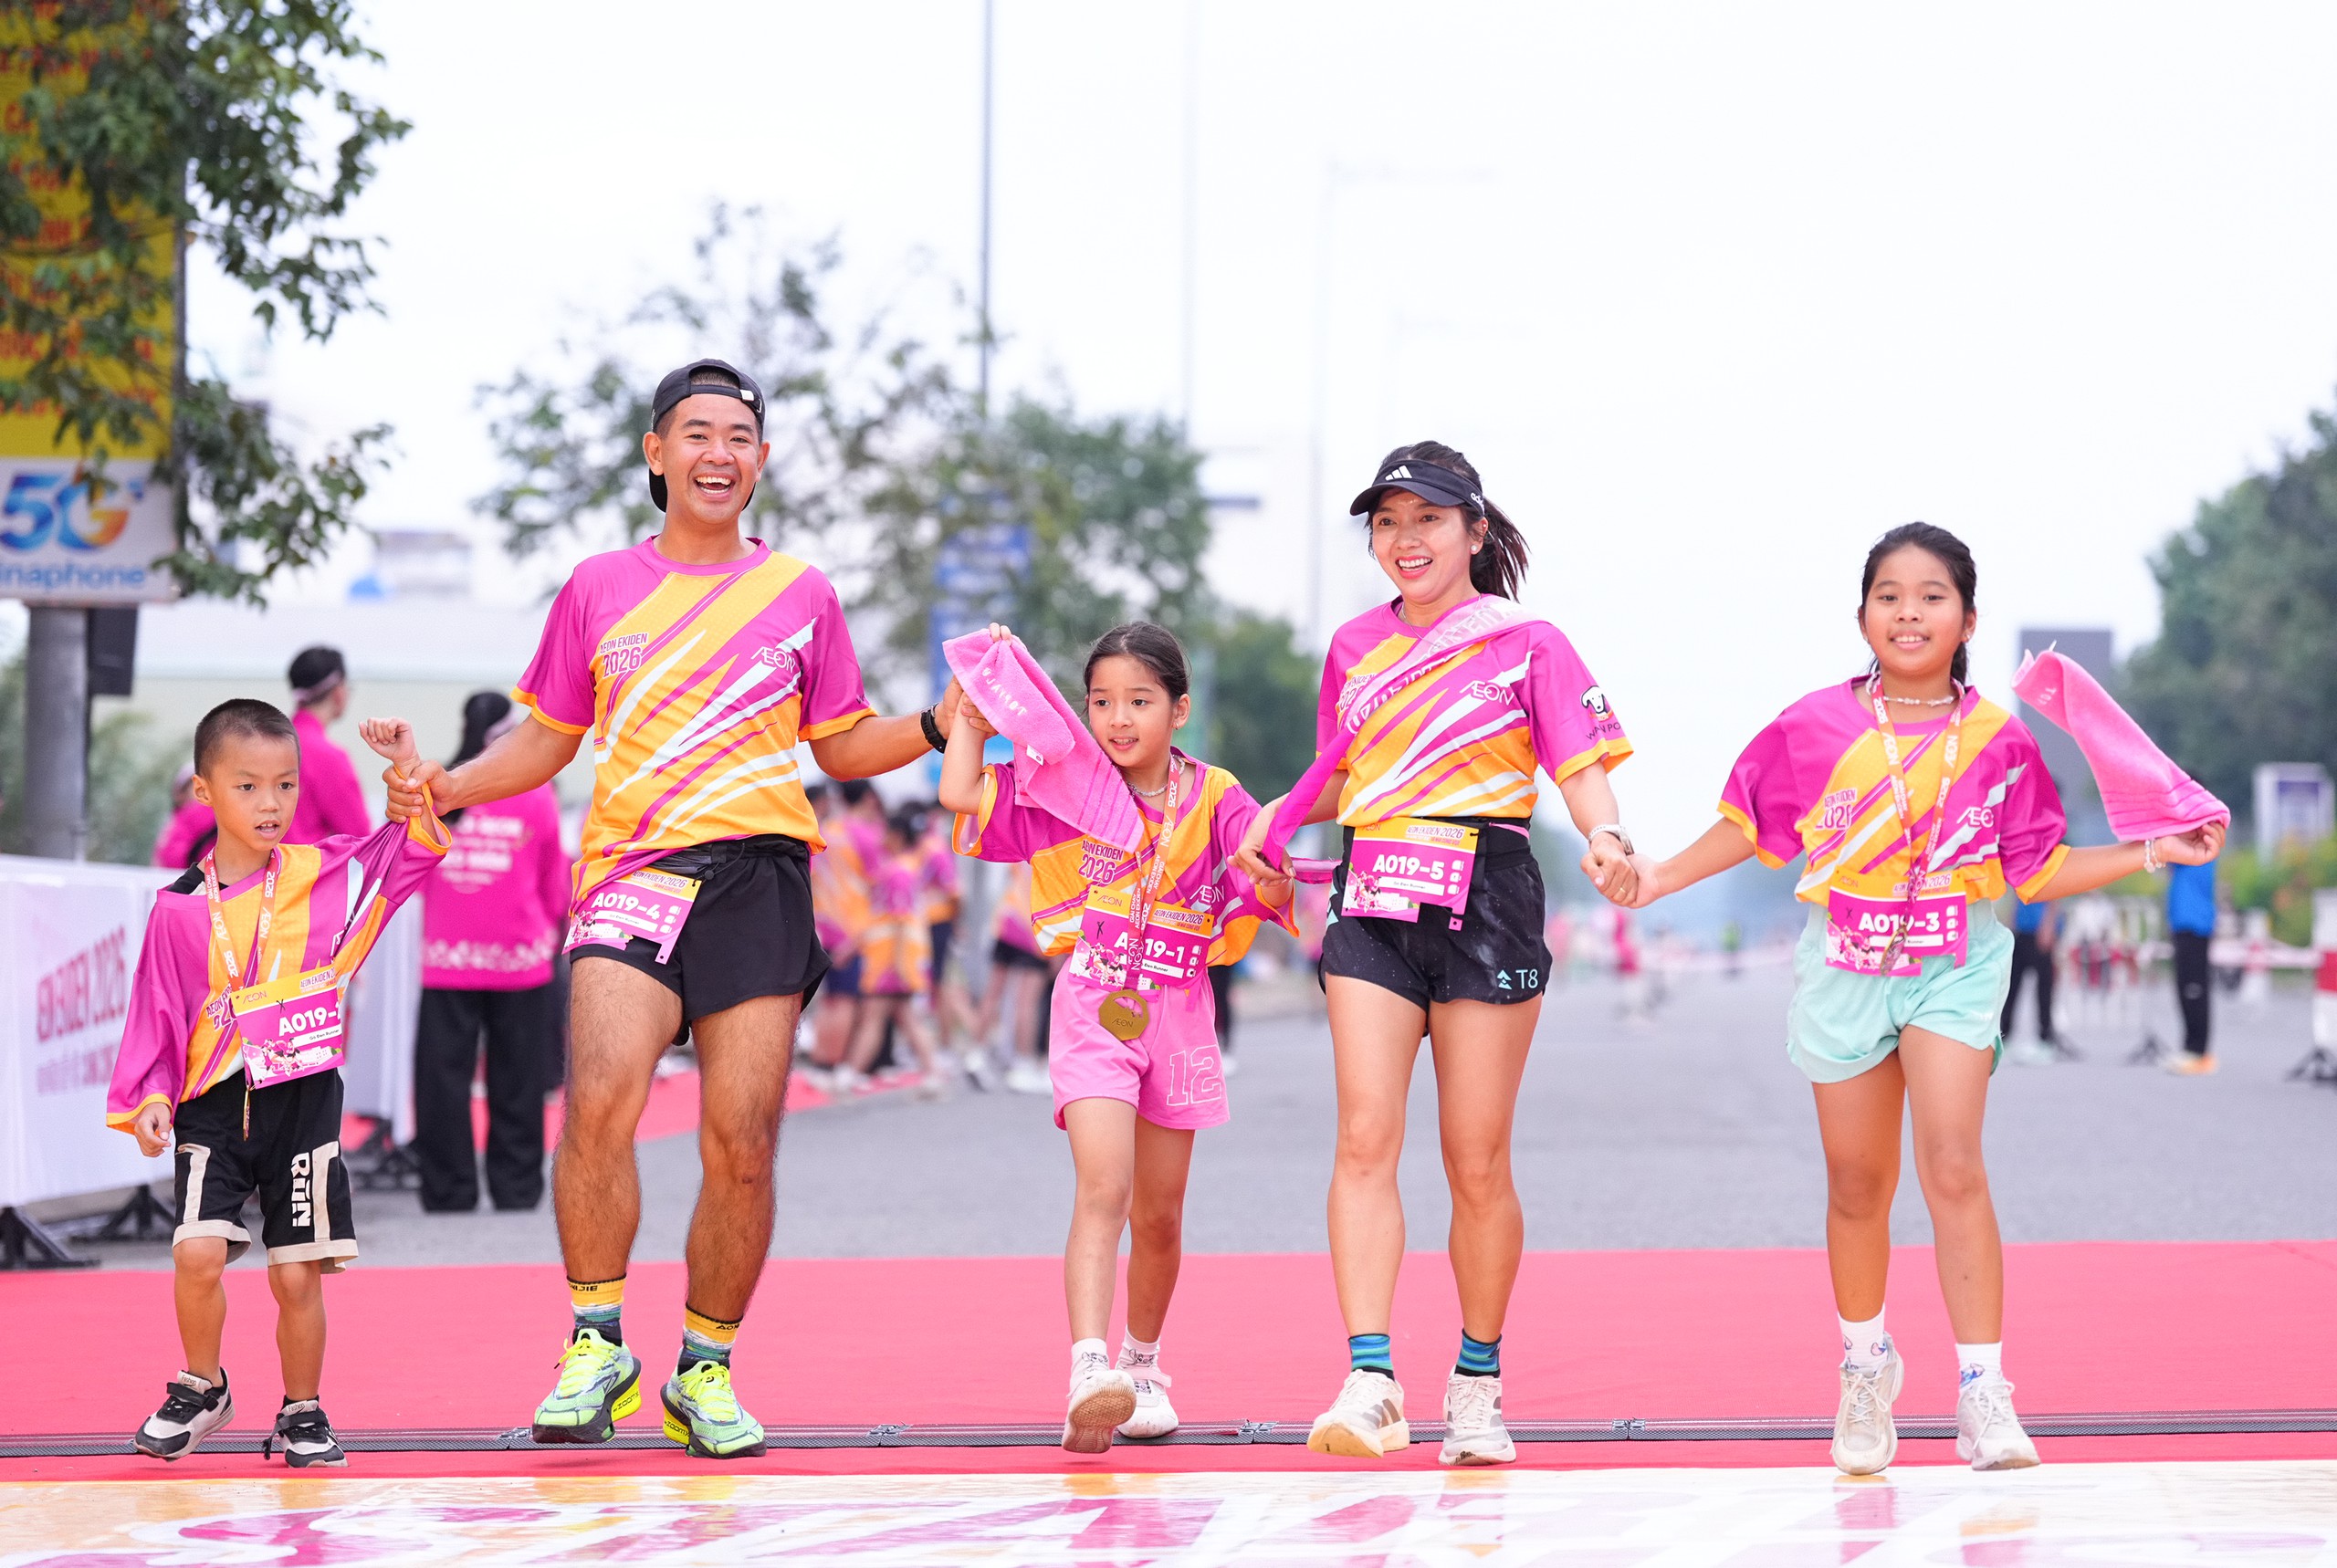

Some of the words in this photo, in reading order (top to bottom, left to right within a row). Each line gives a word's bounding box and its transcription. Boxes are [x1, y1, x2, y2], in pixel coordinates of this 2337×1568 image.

[0, 476, 129, 549] 5G
[618, 632, 648, 647] EKIDEN
[603, 646, 642, 677] 2026
[1168, 780, 1178, 808] 2026
[1441, 828, 1464, 839] 2026
[1095, 844, 1124, 861] EKIDEN
[1078, 854, 1116, 883] 2026
[1372, 854, 1445, 880] A019-5
[265, 871, 276, 898] 2026
[664, 876, 687, 888] 2026
[591, 892, 661, 920] A019-4
[1185, 913, 1204, 925] 2026
[1113, 931, 1185, 964] A19-1
[224, 950, 239, 978] 2026
[1515, 968, 1539, 990] T8
[1167, 1044, 1223, 1106] 12
